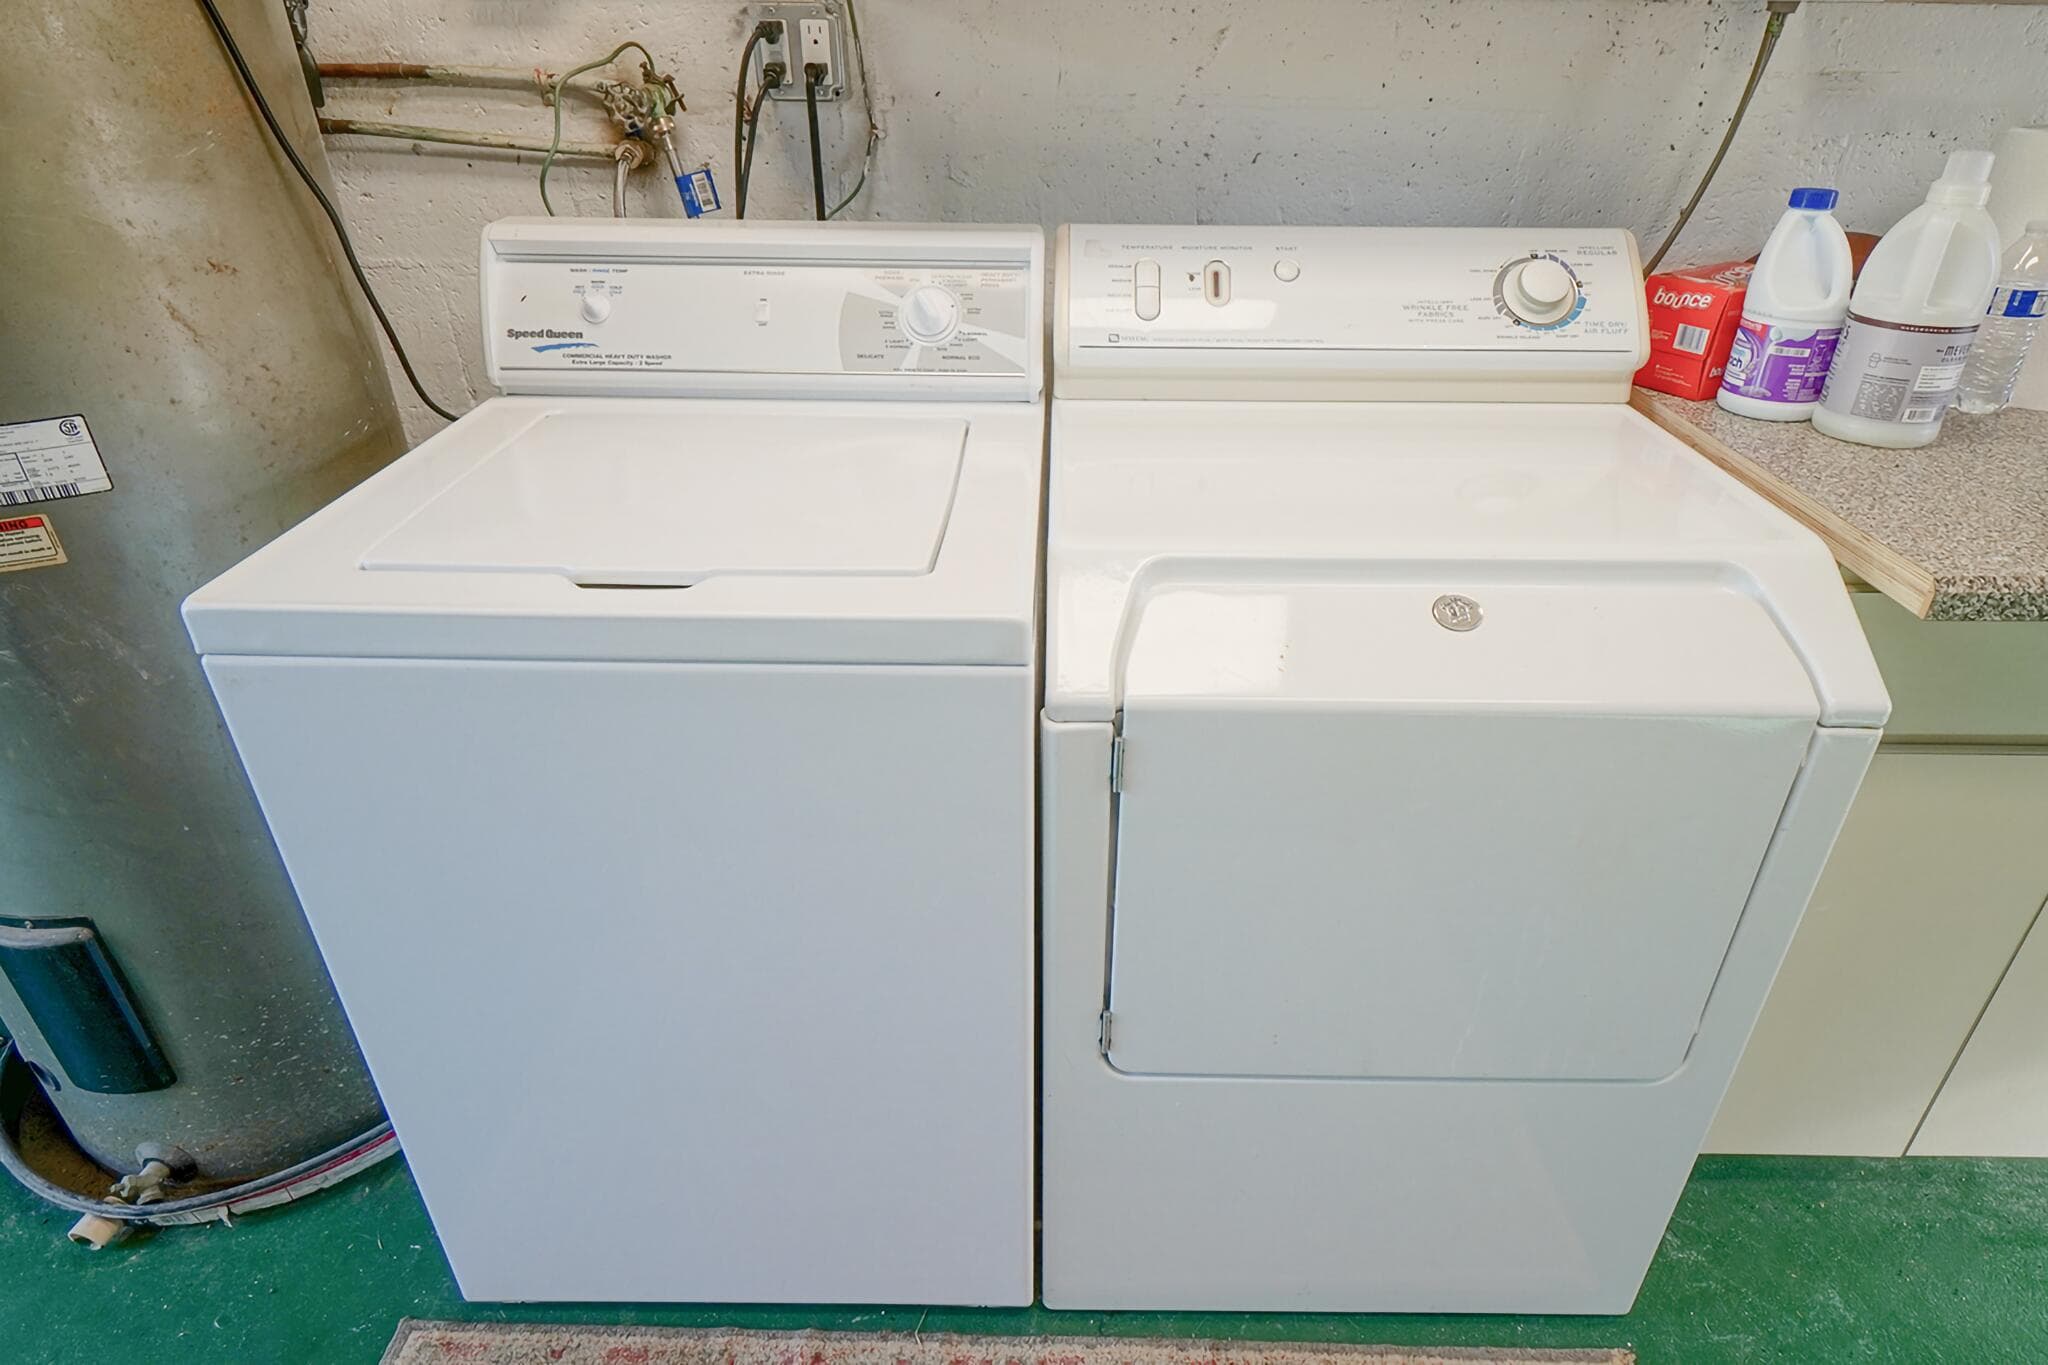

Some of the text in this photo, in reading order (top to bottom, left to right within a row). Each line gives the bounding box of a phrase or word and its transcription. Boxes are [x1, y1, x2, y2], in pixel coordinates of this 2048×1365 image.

[1653, 286, 1713, 309] bounce
[506, 328, 584, 341] Speed Queen
[561, 352, 673, 361] COMMERCIAL HEAVY DUTY WASHER
[571, 358, 588, 366] Extra
[589, 359, 606, 367] Large
[607, 359, 634, 367] Capacity
